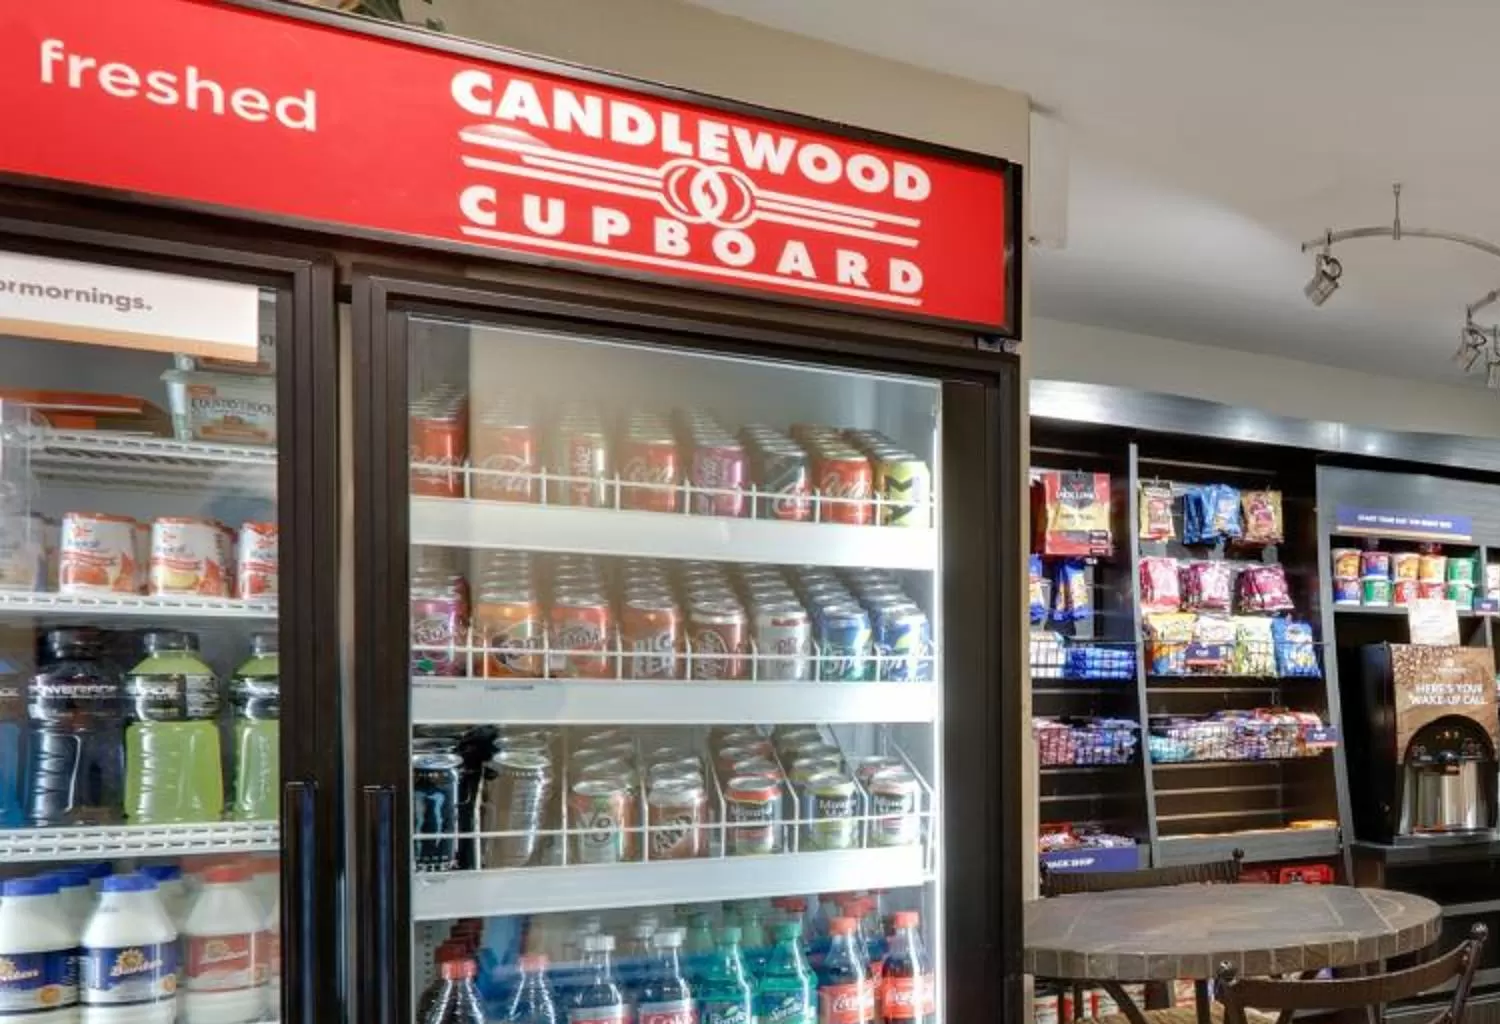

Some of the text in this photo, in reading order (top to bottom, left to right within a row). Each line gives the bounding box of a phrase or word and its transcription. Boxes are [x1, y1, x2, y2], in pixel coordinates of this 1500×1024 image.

[40, 37, 317, 132] freshed
[450, 69, 932, 202] CANDLEWOOD
[459, 185, 924, 294] CUPBOARD
